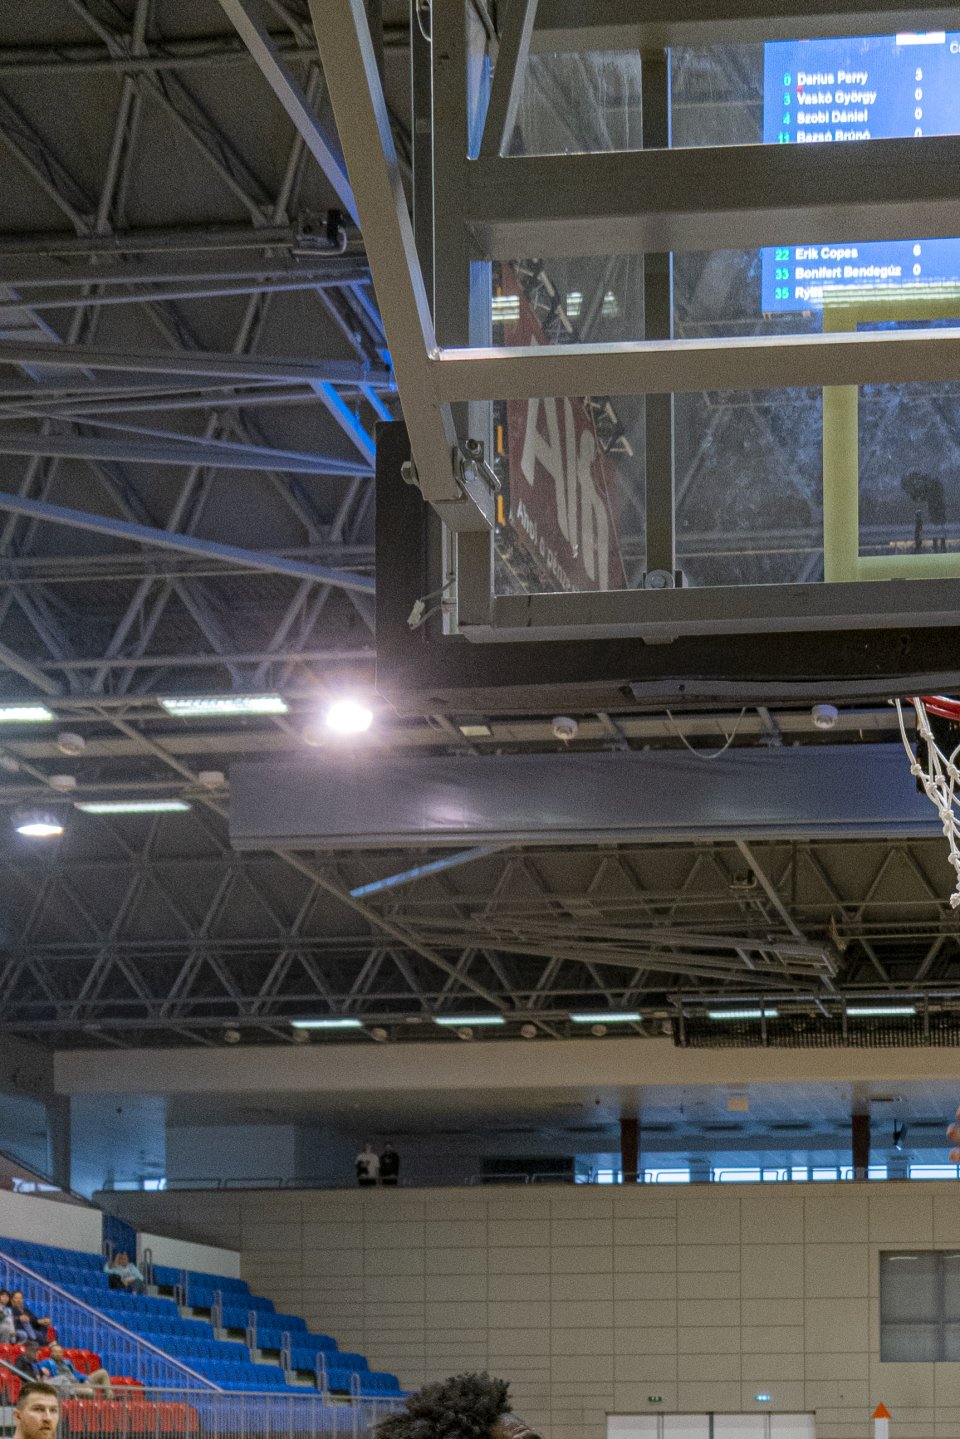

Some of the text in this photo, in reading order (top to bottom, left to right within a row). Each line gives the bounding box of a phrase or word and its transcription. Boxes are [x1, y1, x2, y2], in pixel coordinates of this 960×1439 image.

[797, 71, 834, 85] Darius
[837, 70, 868, 86] Perry
[835, 90, 877, 106] György
[831, 109, 868, 124] Dániel
[914, 107, 923, 120] 0
[775, 249, 789, 261] 22
[795, 248, 819, 260] Erik
[821, 247, 858, 261] Copes
[775, 268, 789, 280] 33
[912, 263, 921, 276] 0
[775, 288, 789, 300] 35
